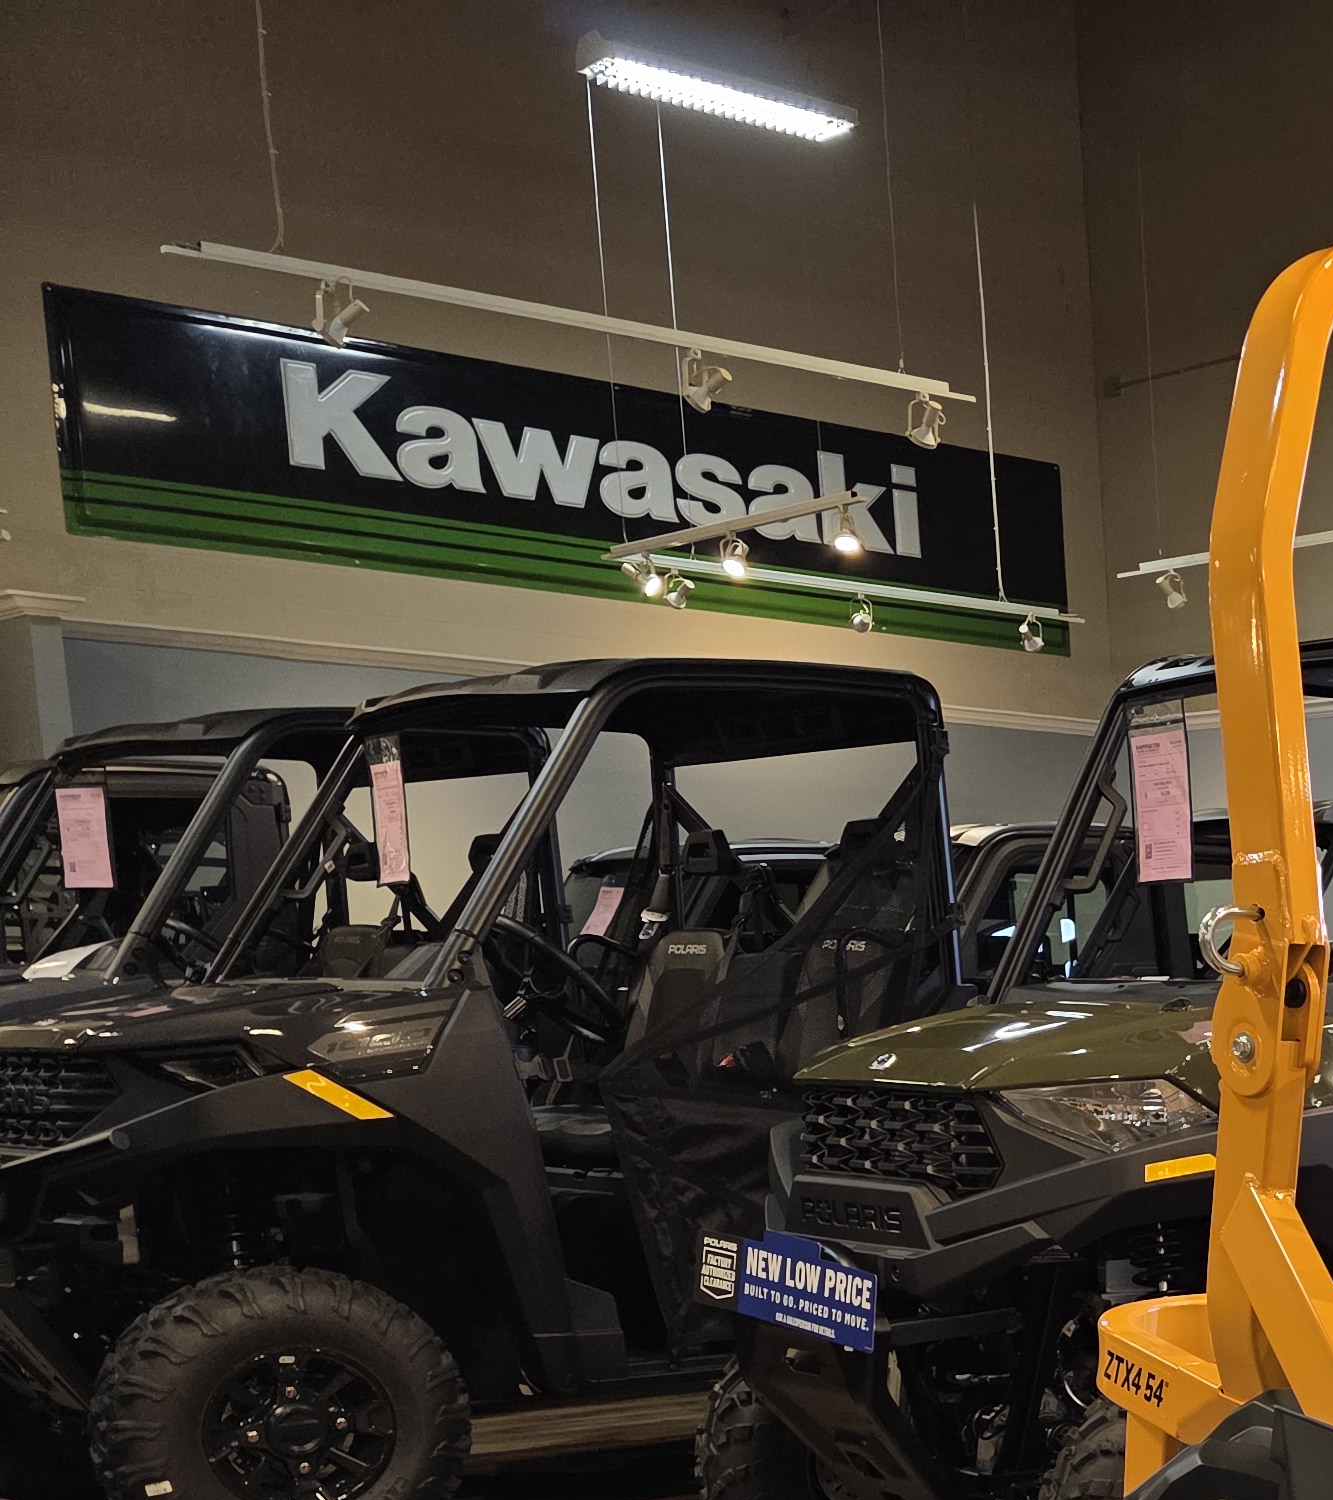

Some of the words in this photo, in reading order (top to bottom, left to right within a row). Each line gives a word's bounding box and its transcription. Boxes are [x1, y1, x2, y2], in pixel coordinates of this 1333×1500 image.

[279, 357, 922, 560] Kawasaki
[668, 944, 707, 955] POLARIS
[822, 940, 866, 951] PORIS
[801, 1199, 901, 1234] POLARIS
[746, 1247, 782, 1283] NEW
[785, 1258, 821, 1294] LOW
[824, 1268, 872, 1310] PRICE
[744, 1283, 769, 1300] BUILT
[770, 1290, 781, 1304] TO
[799, 1299, 829, 1319] PRICED
[831, 1308, 842, 1323] TO
[844, 1312, 870, 1332] MOVE.
[1104, 1350, 1142, 1396] ZTX4
